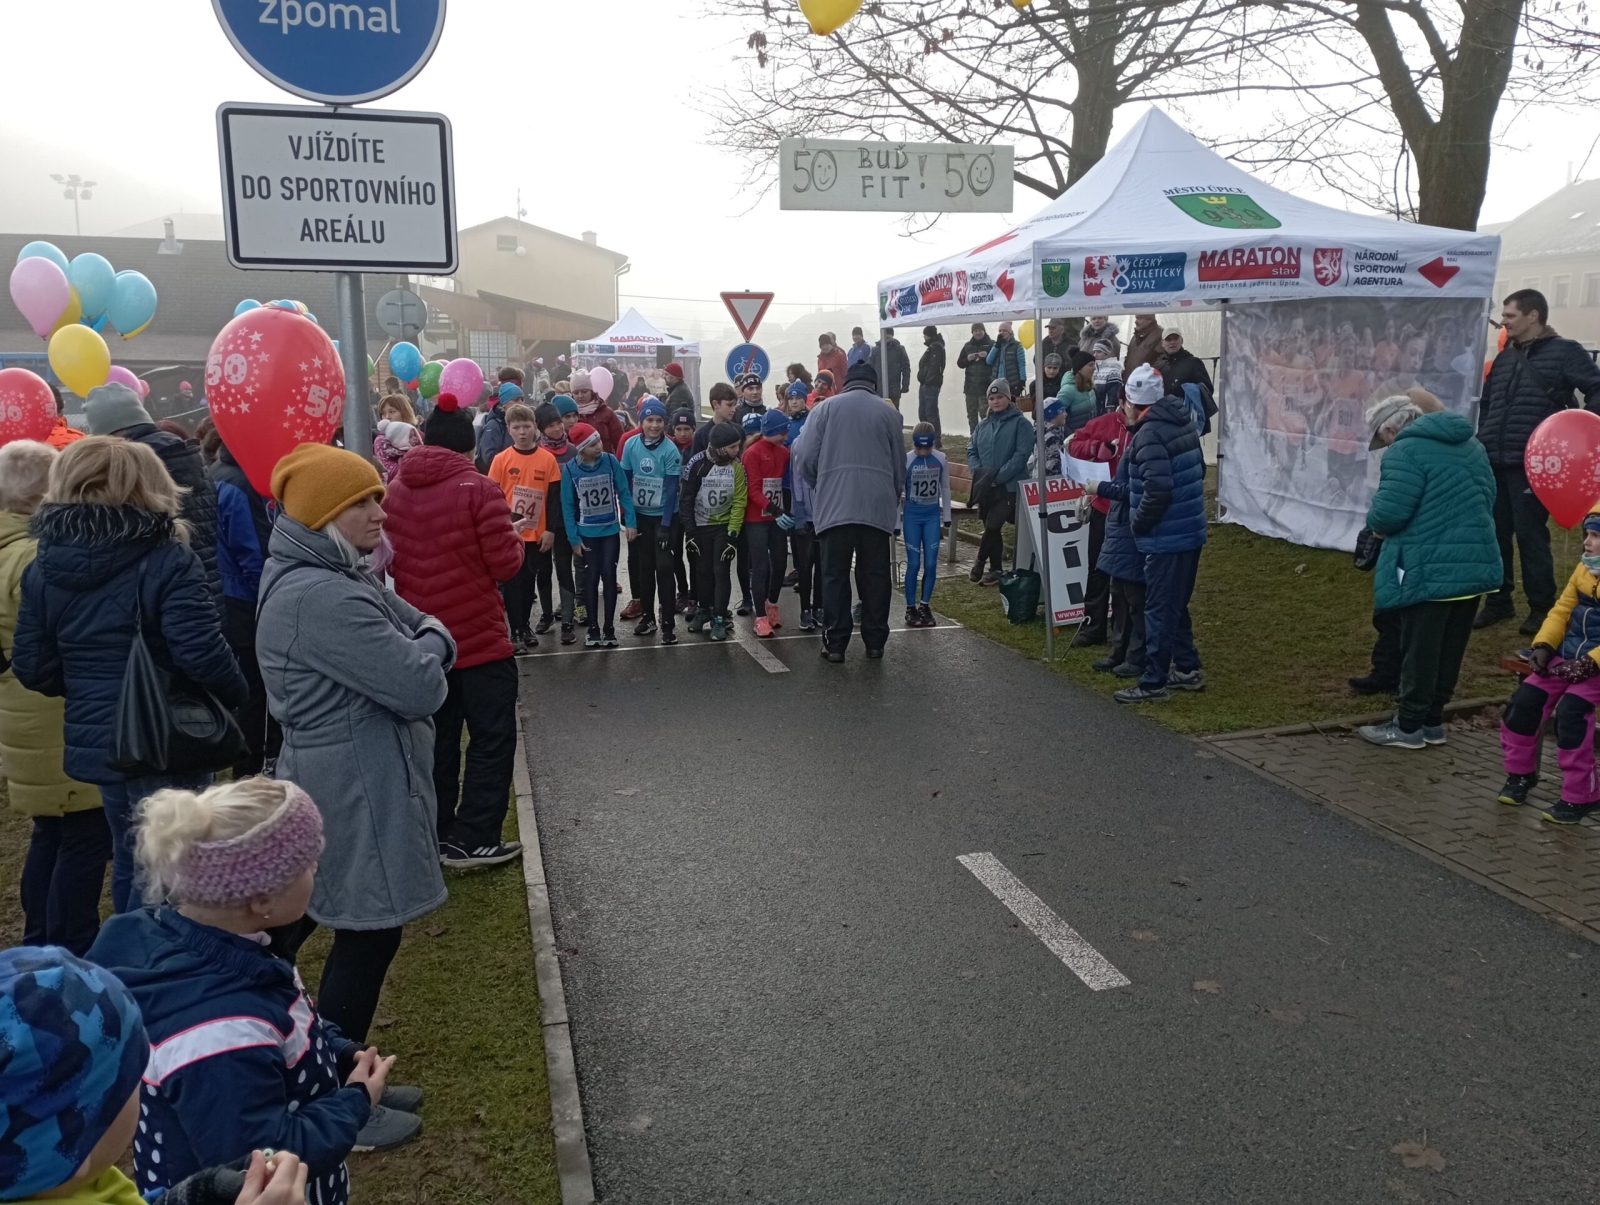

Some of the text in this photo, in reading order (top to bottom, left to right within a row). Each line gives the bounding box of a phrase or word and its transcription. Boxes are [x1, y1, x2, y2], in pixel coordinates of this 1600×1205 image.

[258, 0, 401, 35] zpomal
[288, 130, 386, 164] VJÍŽDÍTE
[792, 149, 838, 193] 50
[944, 153, 995, 197] 50
[241, 174, 437, 206] DO SPORTOVNÍHO
[1162, 184, 1246, 196] MĚSTO ÚPICE
[299, 213, 386, 245] AREÁLU
[1132, 255, 1163, 268] ČESKÝ
[1198, 246, 1302, 268] MARATON
[1354, 249, 1399, 261] NÁRODNÍ
[1130, 266, 1183, 279] ATLETICKÝ
[1271, 266, 1297, 276] stav
[1353, 263, 1408, 274] SPORTOVNÍ
[1131, 280, 1156, 290] SVAZ
[1353, 276, 1404, 286] AGENTURA
[207, 353, 248, 386] 50
[303, 384, 342, 425] 50
[1530, 455, 1562, 475] 50
[582, 487, 611, 508] 132
[637, 488, 656, 507] 87
[913, 479, 938, 497] 123
[707, 489, 728, 508] 65
[514, 499, 537, 520] 64
